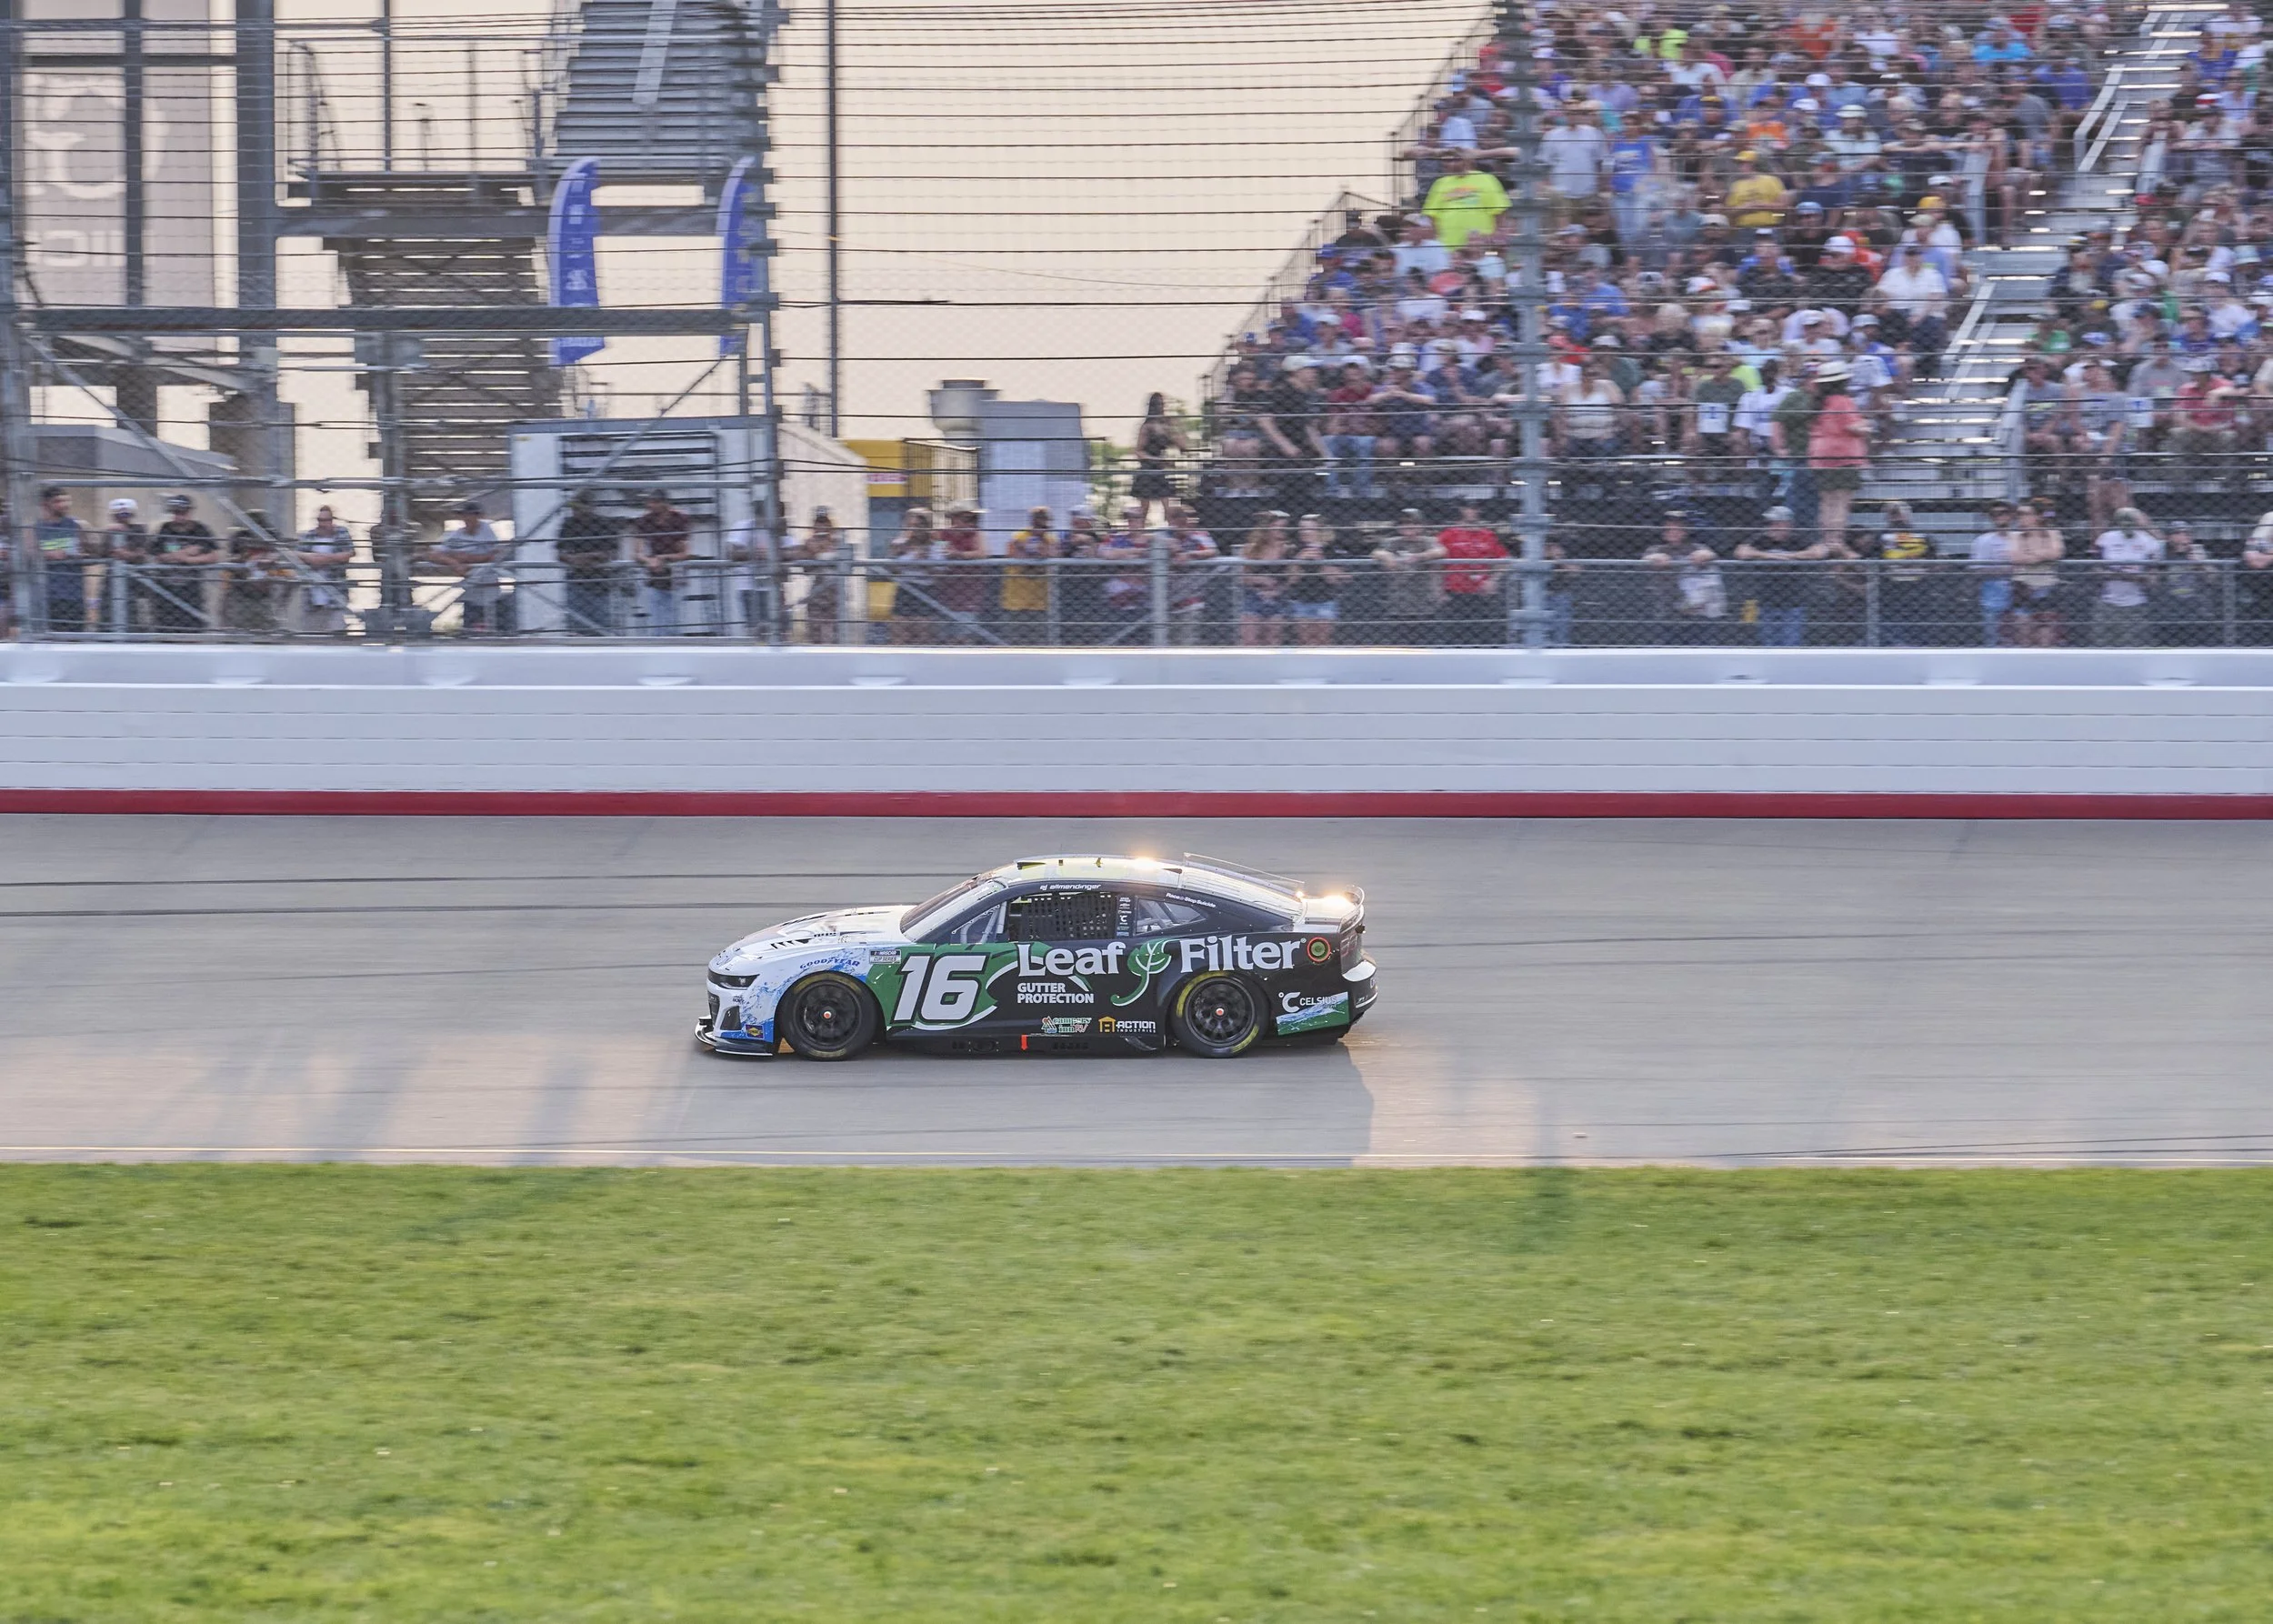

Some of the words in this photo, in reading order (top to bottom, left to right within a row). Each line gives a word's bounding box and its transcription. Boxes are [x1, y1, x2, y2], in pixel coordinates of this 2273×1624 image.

[799, 956, 860, 969] GOODYEAR
[1016, 941, 1126, 977] Leaf
[893, 955, 986, 1022] 16
[1016, 982, 1066, 994] GUTTER
[1016, 993, 1095, 1004] PROTECTION
[1299, 996, 1337, 1006] CELSIUS
[1116, 1020, 1157, 1029] ACTION
